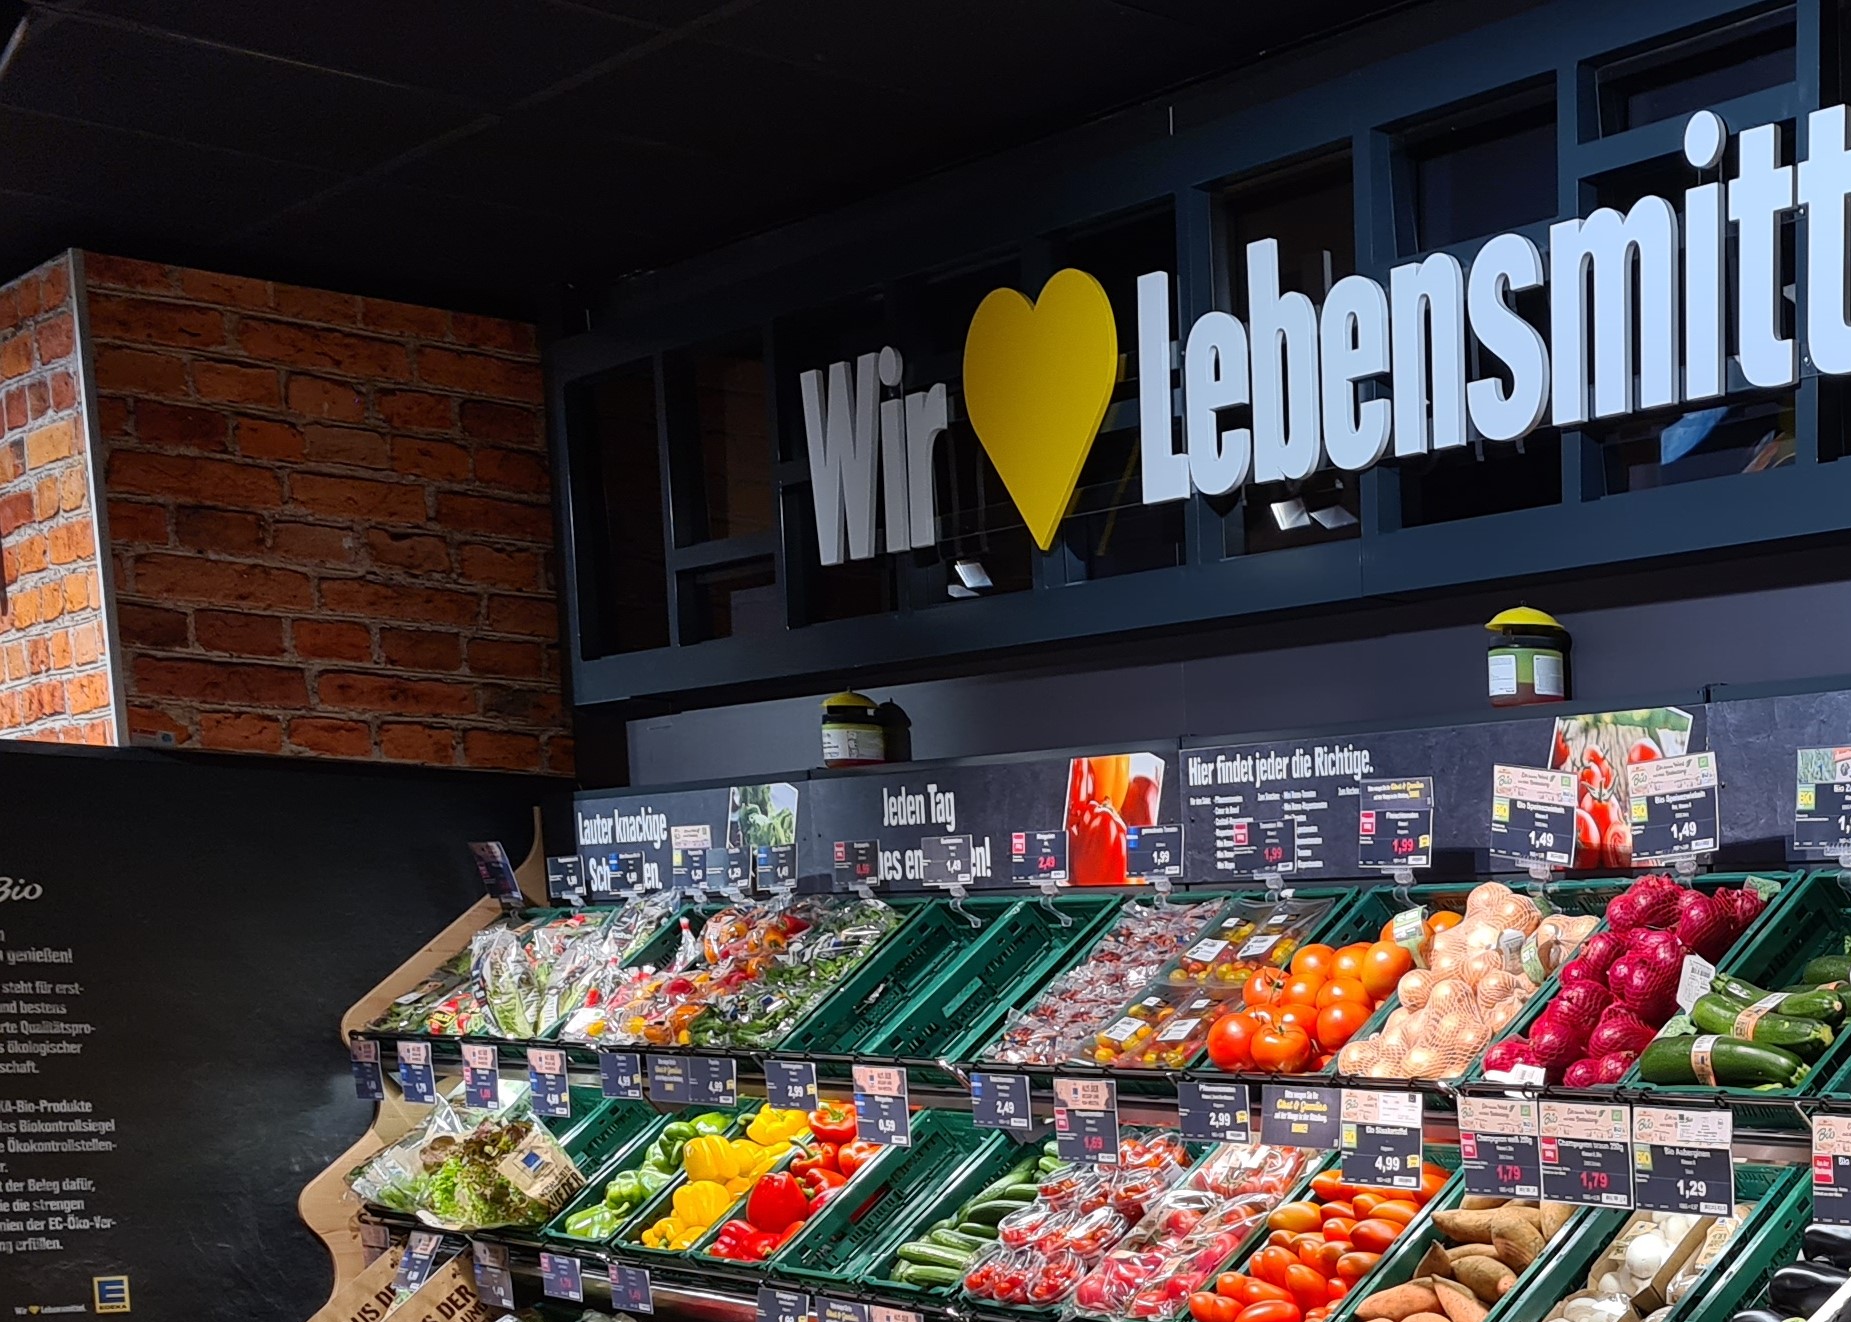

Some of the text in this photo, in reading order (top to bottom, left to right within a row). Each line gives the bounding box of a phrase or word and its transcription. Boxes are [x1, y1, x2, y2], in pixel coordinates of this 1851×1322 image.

[799, 346, 949, 566] Wir
[1188, 744, 1374, 788] Hier findet jeder die Richtige.
[882, 783, 956, 833] Jeden Tag
[577, 807, 668, 849] Lauter knackige
[1670, 821, 1697, 841] 1,49
[1529, 830, 1554, 848] 1,49
[7, 948, 73, 965] genießen!
[35, 980, 52, 994] für
[7, 1041, 83, 1056] ökologischer
[1209, 1111, 1231, 1128] 2,99
[1374, 1155, 1400, 1173] 4,99
[1496, 1165, 1522, 1182] 1,79
[1580, 1172, 1609, 1190] 1,79
[6, 1180, 25, 1192] der
[27, 1179, 60, 1194] Beleg
[1676, 1179, 1707, 1199] 1,29
[13, 1199, 85, 1213] die strengen
[26, 1219, 46, 1231] der
[436, 1283, 477, 1322] DER
